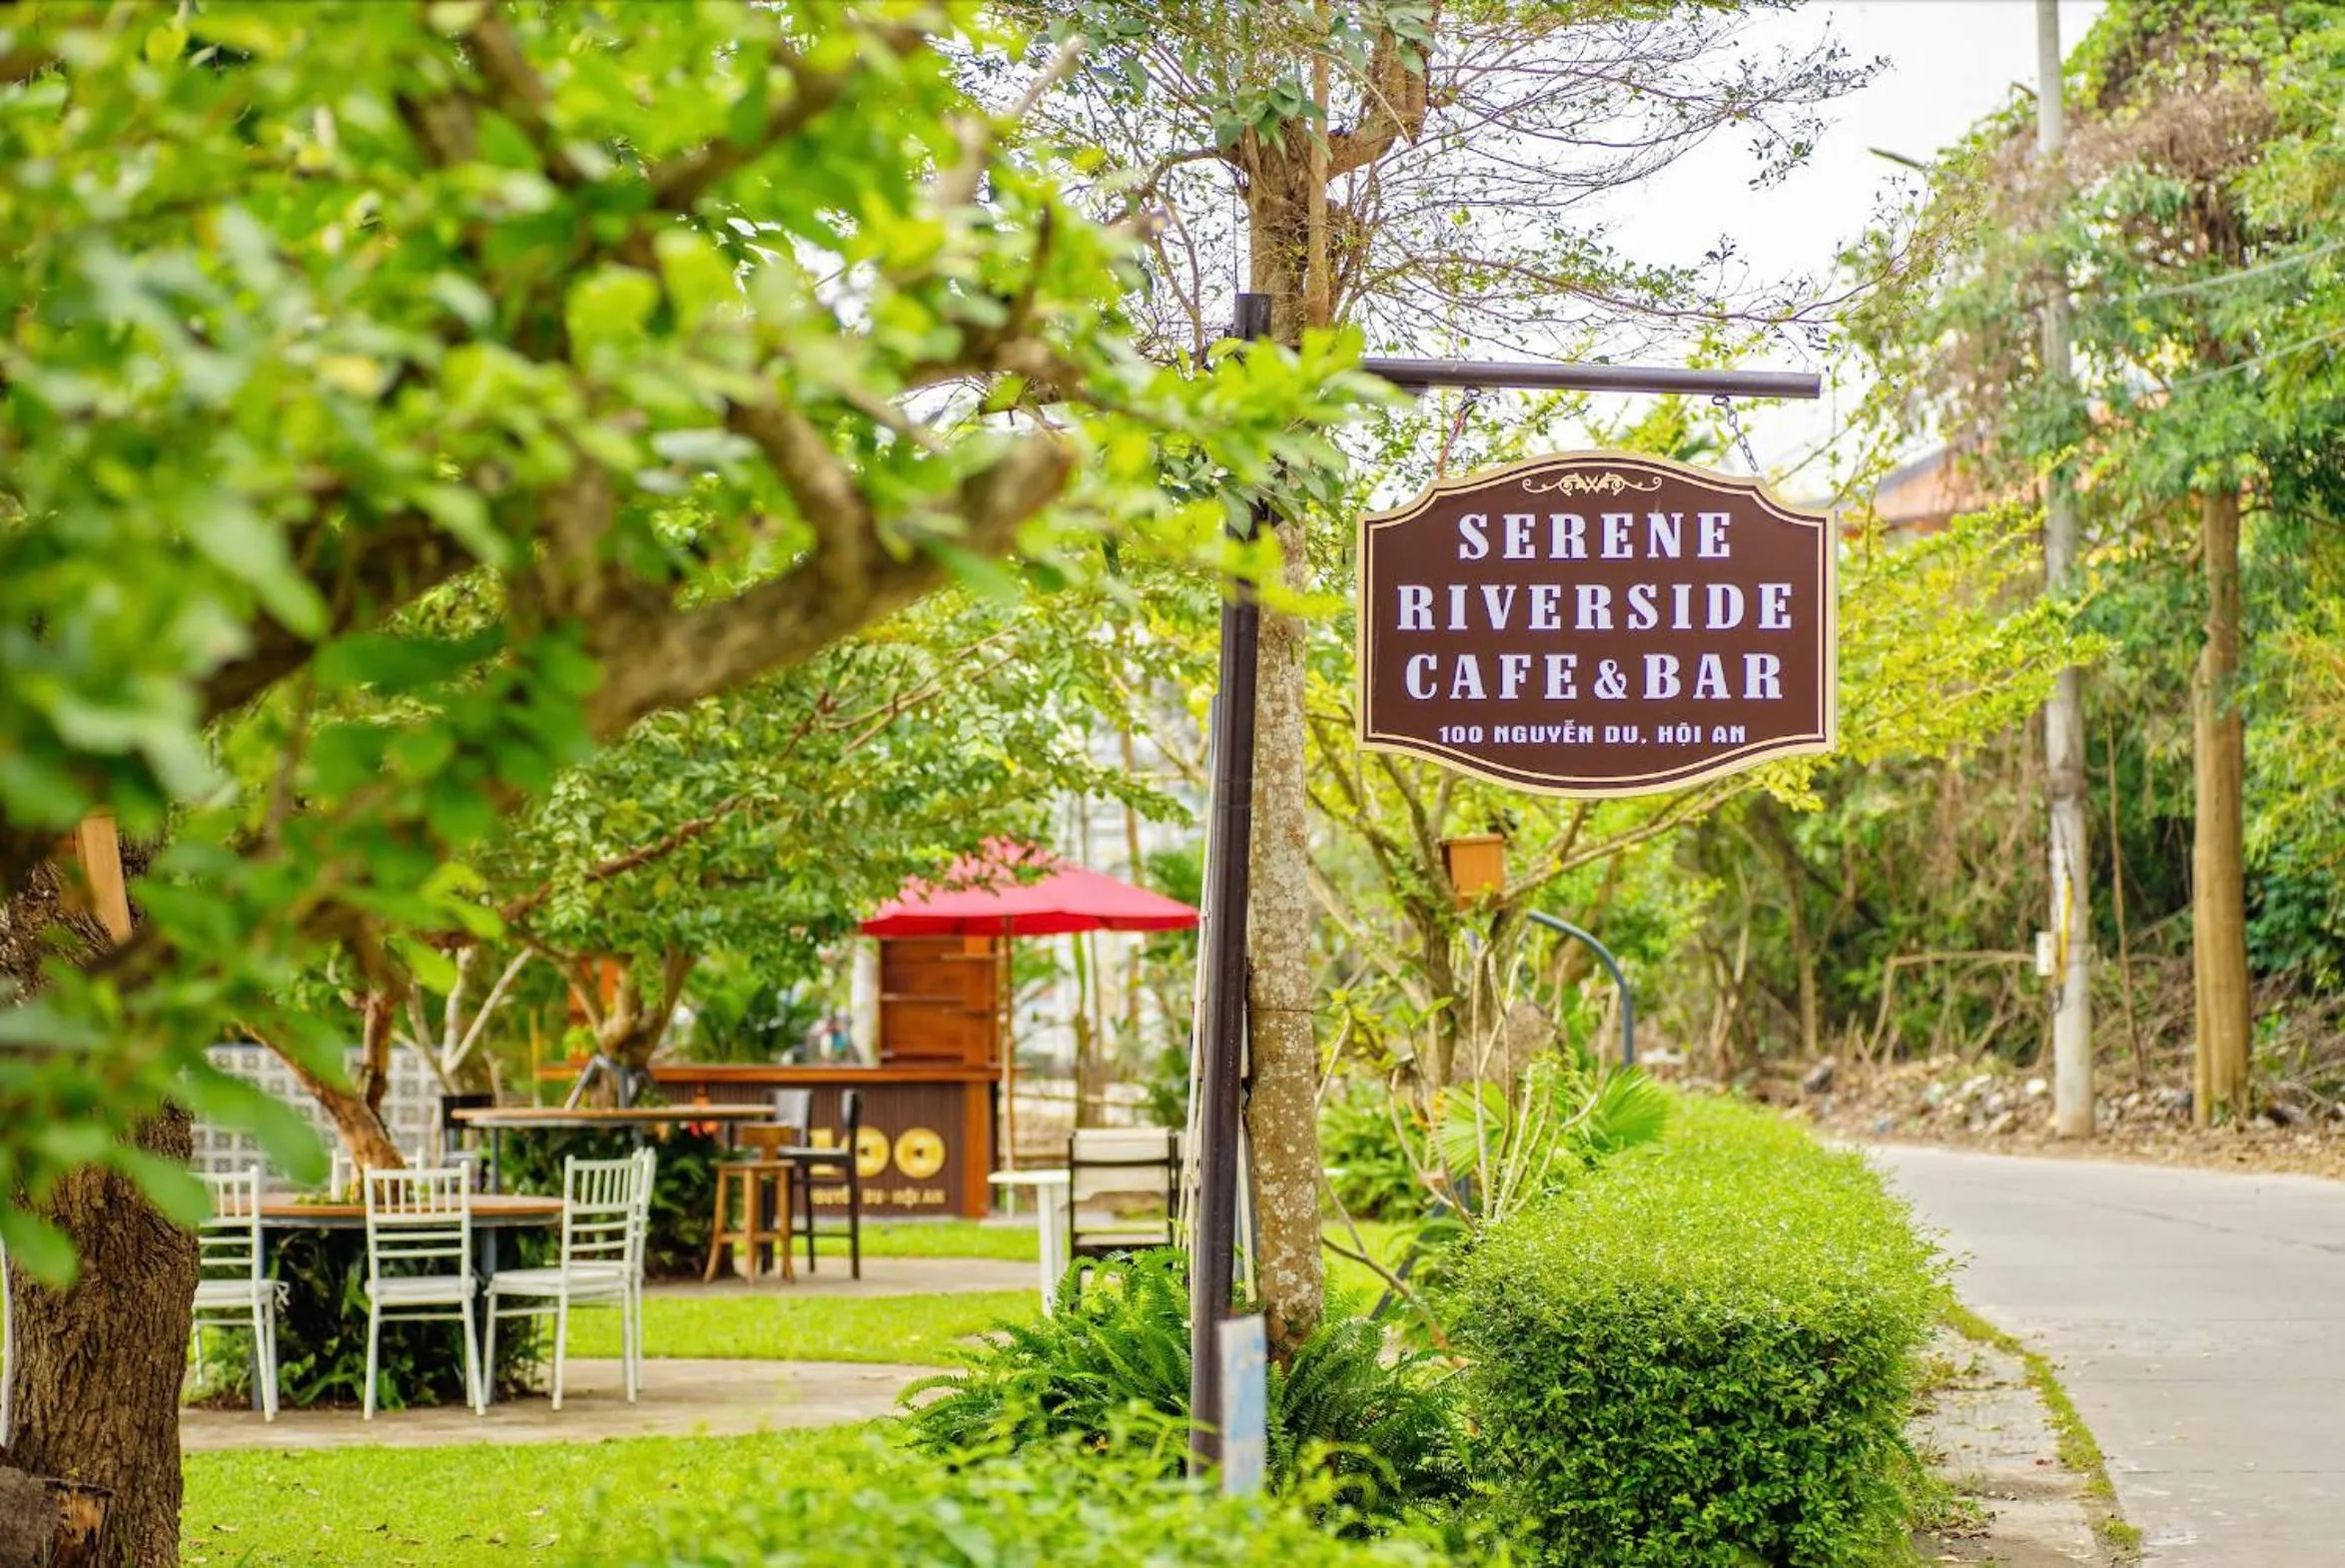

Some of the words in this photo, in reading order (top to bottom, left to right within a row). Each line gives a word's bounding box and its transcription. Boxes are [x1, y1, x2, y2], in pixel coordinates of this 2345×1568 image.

[1459, 511, 1732, 560] SERENE
[1397, 583, 1793, 631] RIVERSIDE
[1438, 726, 1484, 743] 100
[1494, 719, 1594, 744] NGUYỄN
[1658, 722, 1702, 746] HỘI
[1712, 725, 1746, 743] AN
